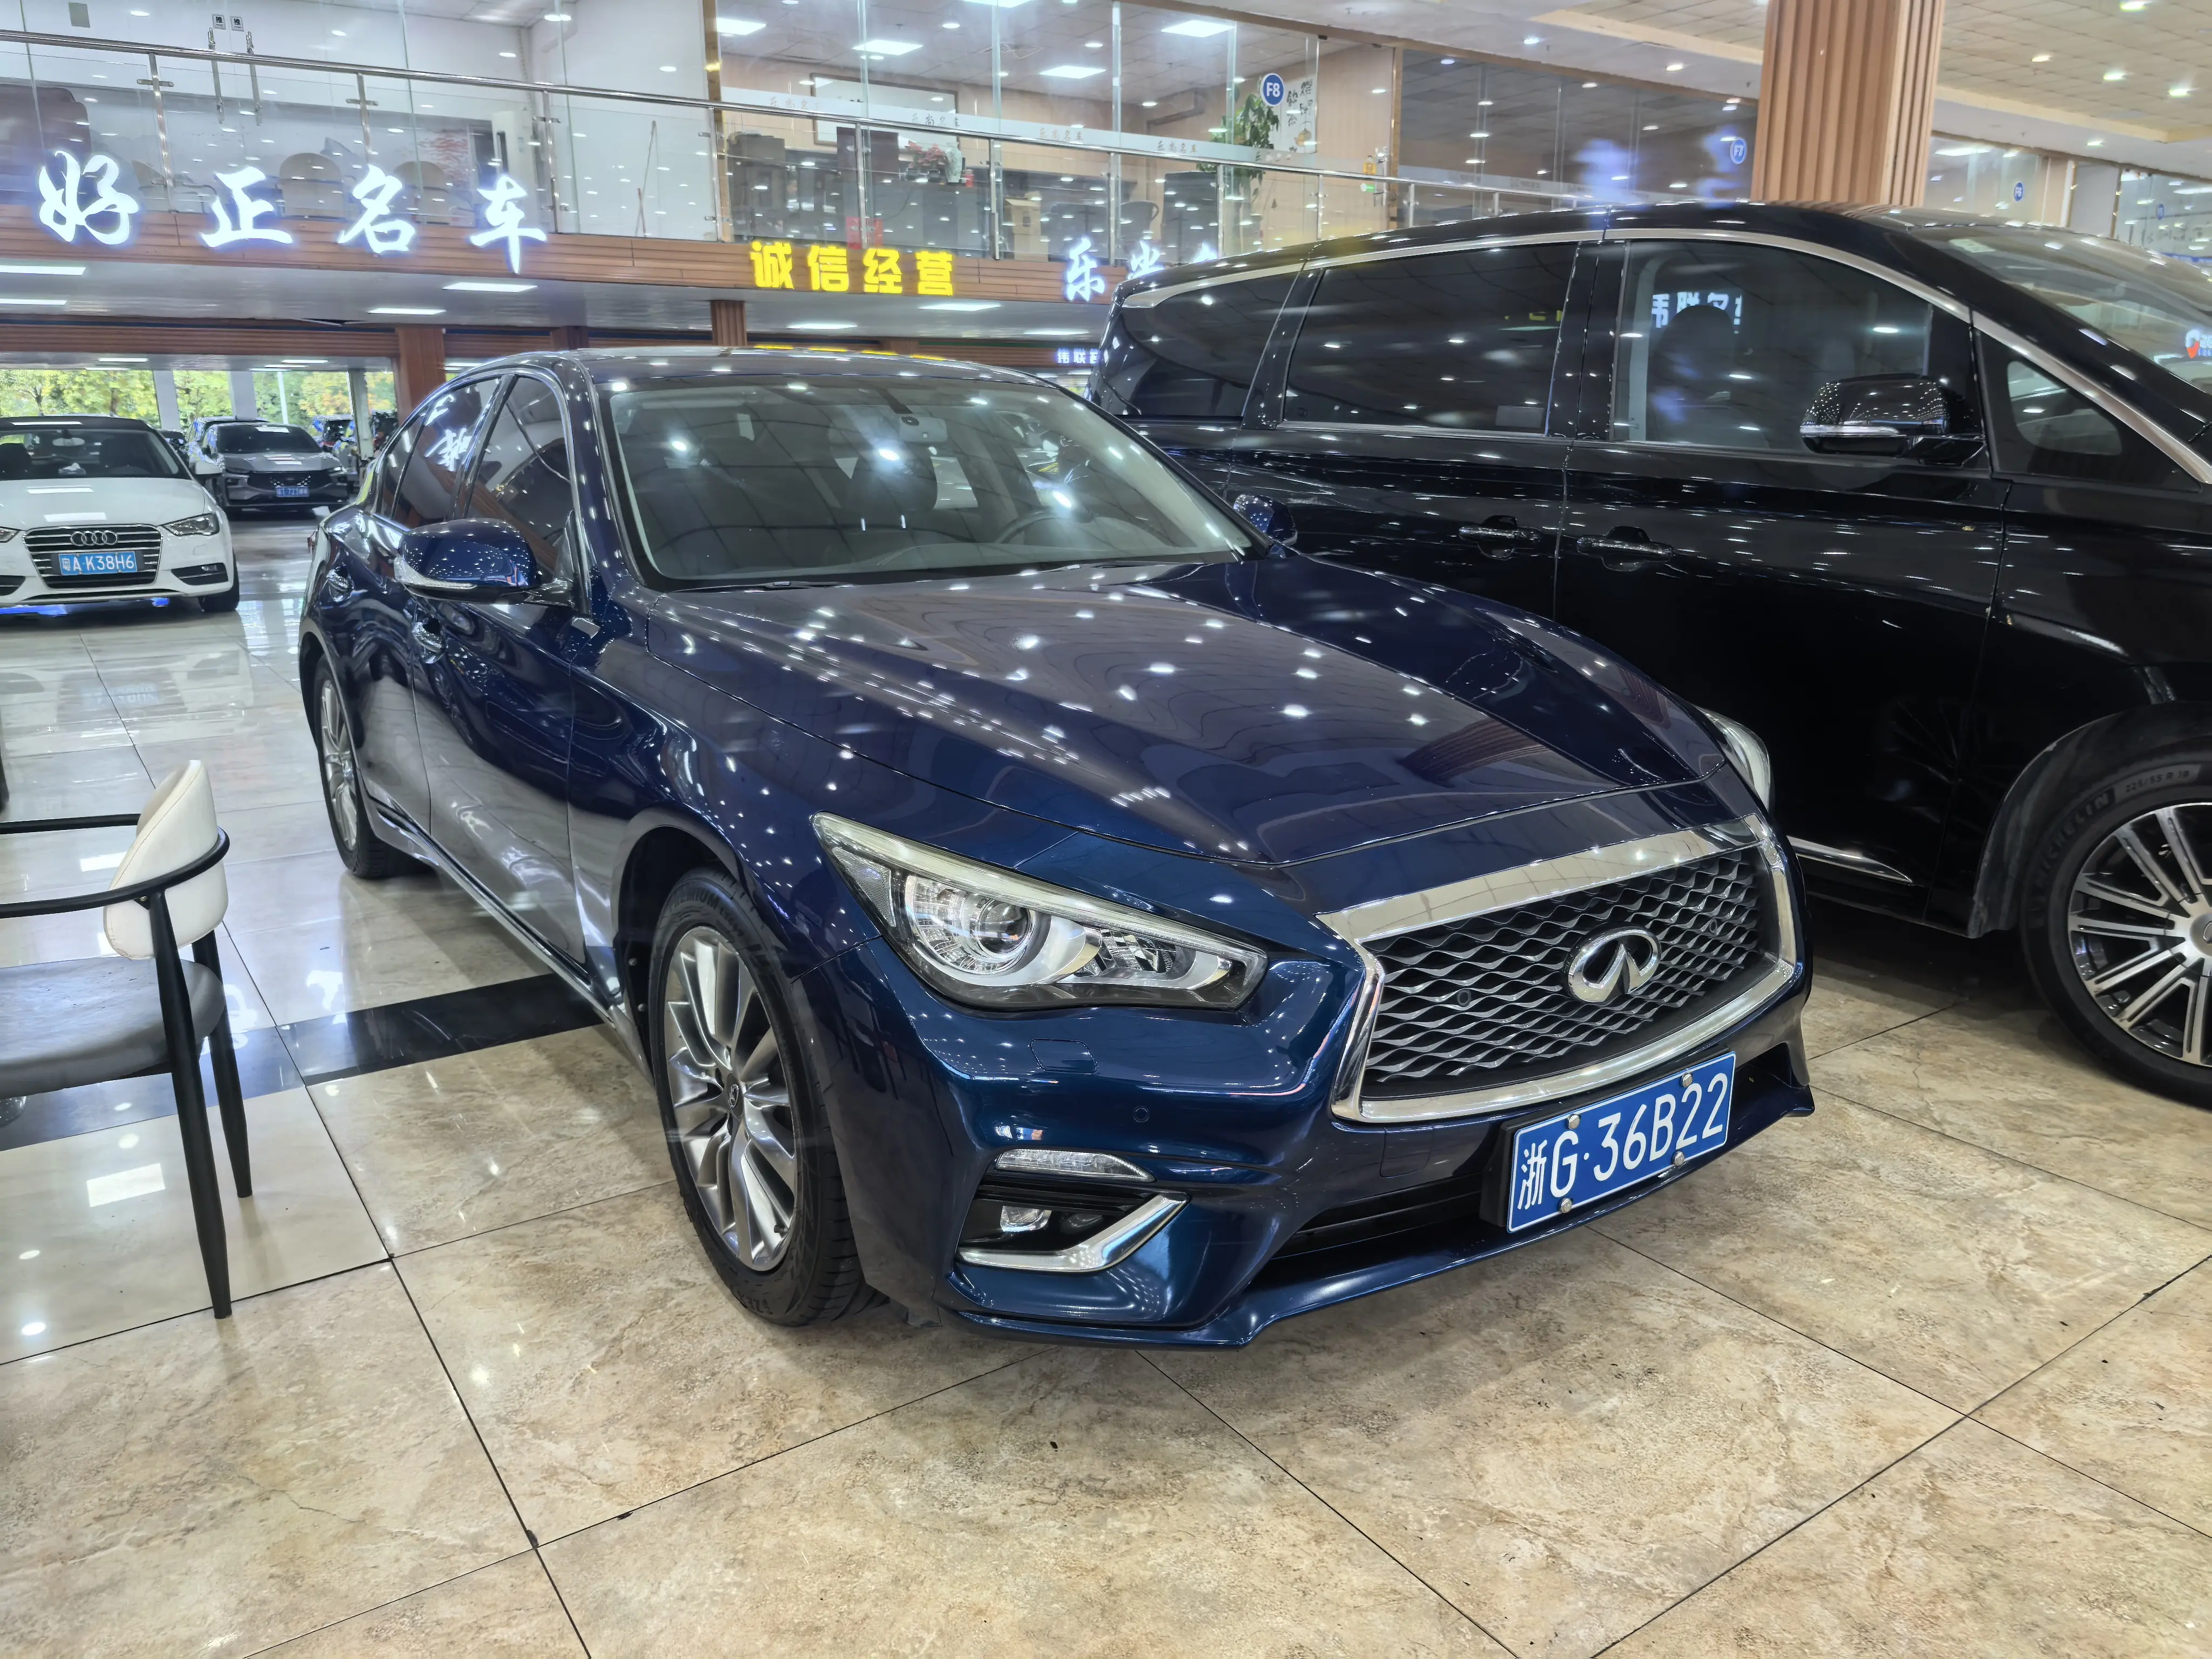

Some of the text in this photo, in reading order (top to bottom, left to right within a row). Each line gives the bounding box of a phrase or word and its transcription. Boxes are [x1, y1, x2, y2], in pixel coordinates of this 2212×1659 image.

[1266, 82, 1280, 97] F8
[1734, 144, 1744, 157] F7
[38, 150, 547, 274] 好正名车
[749, 240, 955, 296] 诚信经营
